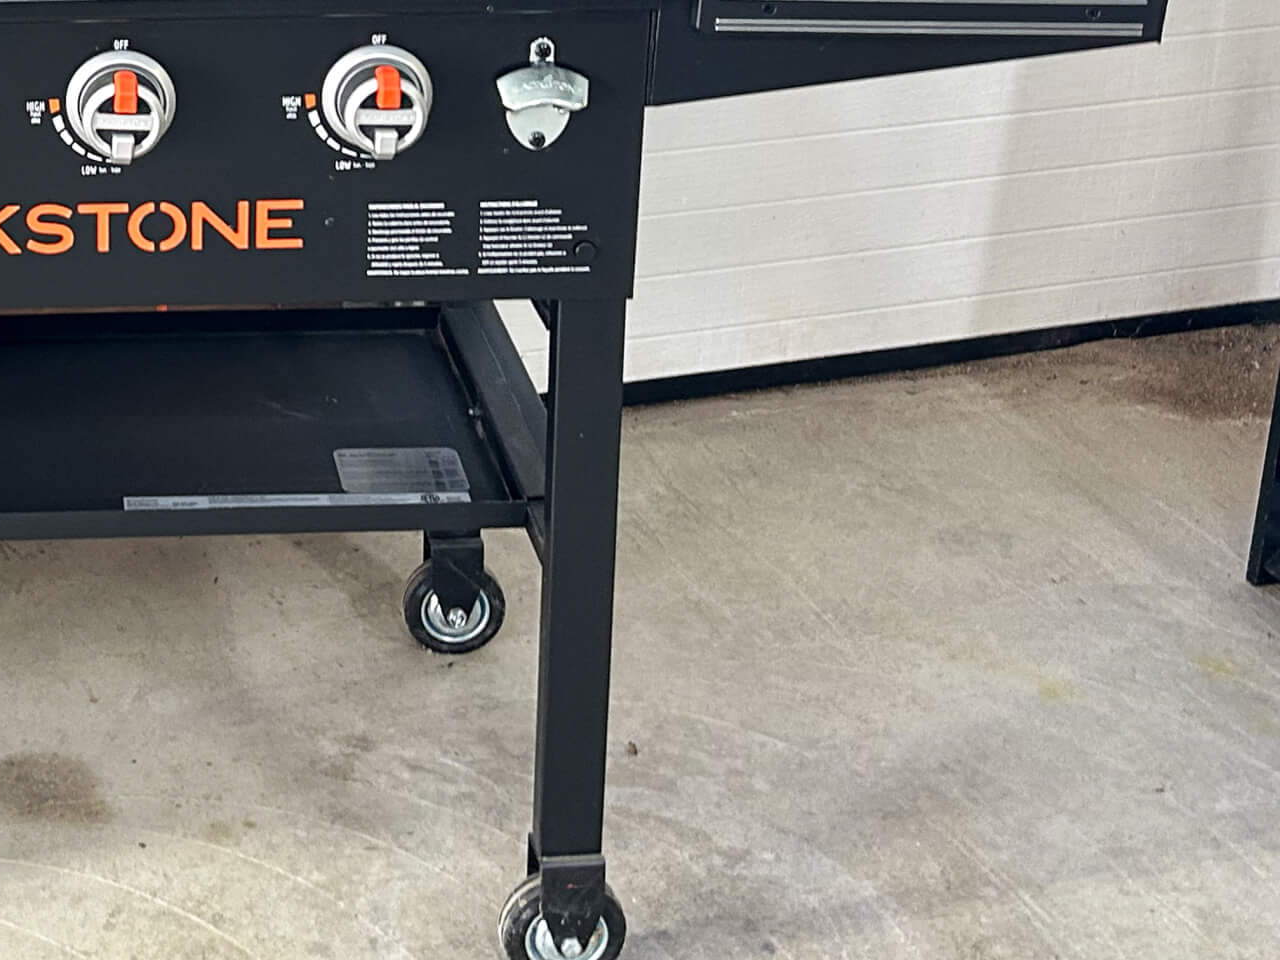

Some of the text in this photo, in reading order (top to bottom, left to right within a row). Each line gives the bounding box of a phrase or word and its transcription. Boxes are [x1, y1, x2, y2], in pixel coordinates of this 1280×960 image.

[113, 39, 129, 50] OFF
[371, 34, 387, 45] OFF
[81, 166, 97, 176] LOW
[335, 161, 351, 171] LOW
